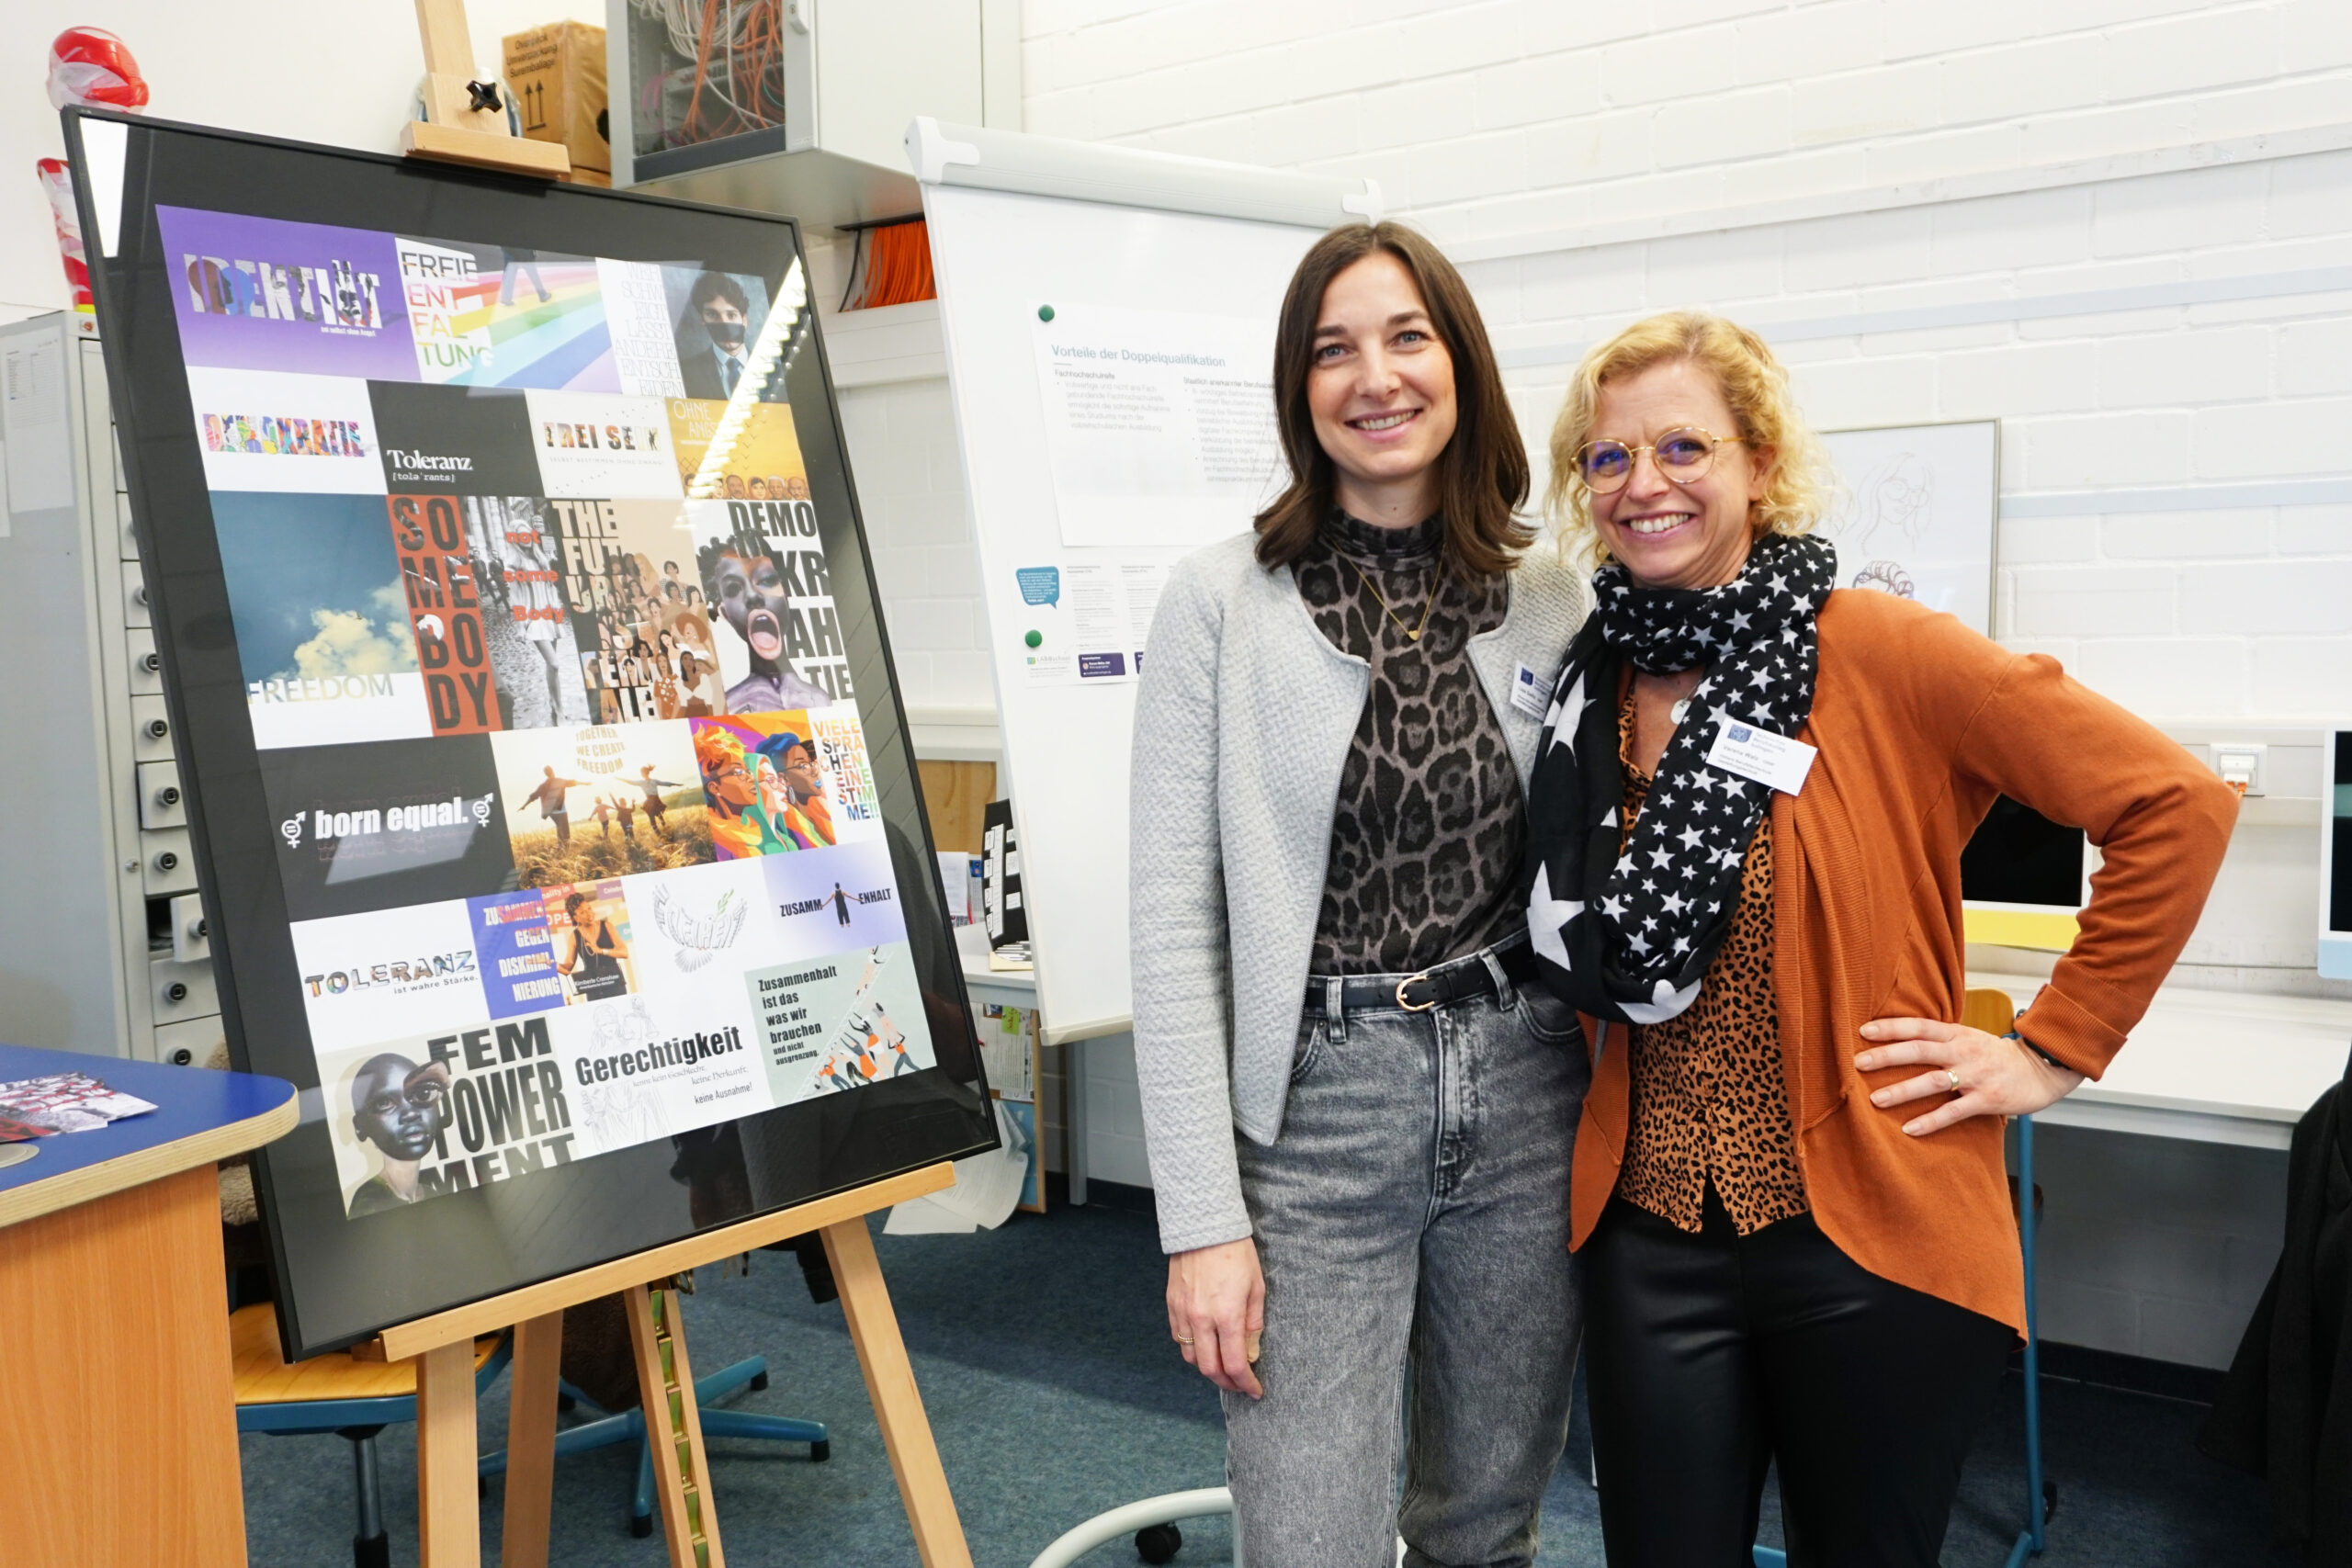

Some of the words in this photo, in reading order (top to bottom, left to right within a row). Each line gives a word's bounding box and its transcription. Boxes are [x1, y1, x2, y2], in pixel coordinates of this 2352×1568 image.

[401, 252, 479, 282] FREIE
[1052, 344, 1096, 359] Vorteile
[1100, 347, 1118, 360] der
[1122, 349, 1226, 367] Doppelqualifikation
[673, 400, 710, 420] OHNE
[203, 413, 365, 457] DEMOKRATIE
[544, 422, 599, 449] FREI
[689, 420, 721, 438] ANGS
[388, 450, 473, 470] Toleranz
[392, 497, 459, 551] SO
[552, 501, 618, 537] THE
[727, 502, 817, 537] DEMO
[506, 530, 540, 544] not
[401, 555, 476, 608] ME
[503, 570, 559, 582] some
[772, 550, 829, 597] KR
[513, 605, 564, 624] Body
[415, 613, 484, 670] BO
[785, 606, 843, 658] AH
[247, 674, 394, 704] FREEDOM
[805, 664, 854, 700] TIE
[428, 672, 488, 729] DY
[576, 727, 617, 741] TOGETHER
[813, 718, 861, 737] VIELE
[577, 745, 590, 756] WE
[593, 742, 625, 756] CREATE
[822, 735, 865, 754] SPRA
[577, 758, 623, 773] FREEDOM
[819, 751, 864, 772] CHEN
[835, 769, 872, 787] EINE
[838, 785, 875, 805] STIM
[315, 809, 381, 840] born
[387, 797, 469, 831] equal.
[846, 803, 879, 820] ME!!
[858, 888, 891, 905] ENHALT
[514, 927, 549, 948] GEGEN
[304, 951, 476, 998] TOLERANZ
[393, 986, 407, 995] ist
[411, 981, 440, 992] wahre
[444, 974, 479, 987] Stärke.
[758, 966, 838, 991] Zusammenhalt
[513, 977, 561, 1002] NIERUNG
[763, 996, 777, 1009] ist
[779, 991, 798, 1007] das
[766, 1014, 788, 1026] was
[790, 1008, 807, 1021] wir
[771, 1022, 822, 1043] brauchen
[428, 1017, 552, 1074] FEM
[576, 1025, 742, 1086] Gerechtigkeit
[774, 1045, 786, 1055] und
[787, 1042, 805, 1054] nicht
[775, 1051, 820, 1066] ausgrenzung.
[692, 1076, 711, 1086] keine
[695, 1093, 714, 1104] keine
[716, 1082, 752, 1100] Ausnahme!
[433, 1060, 571, 1161] POWER
